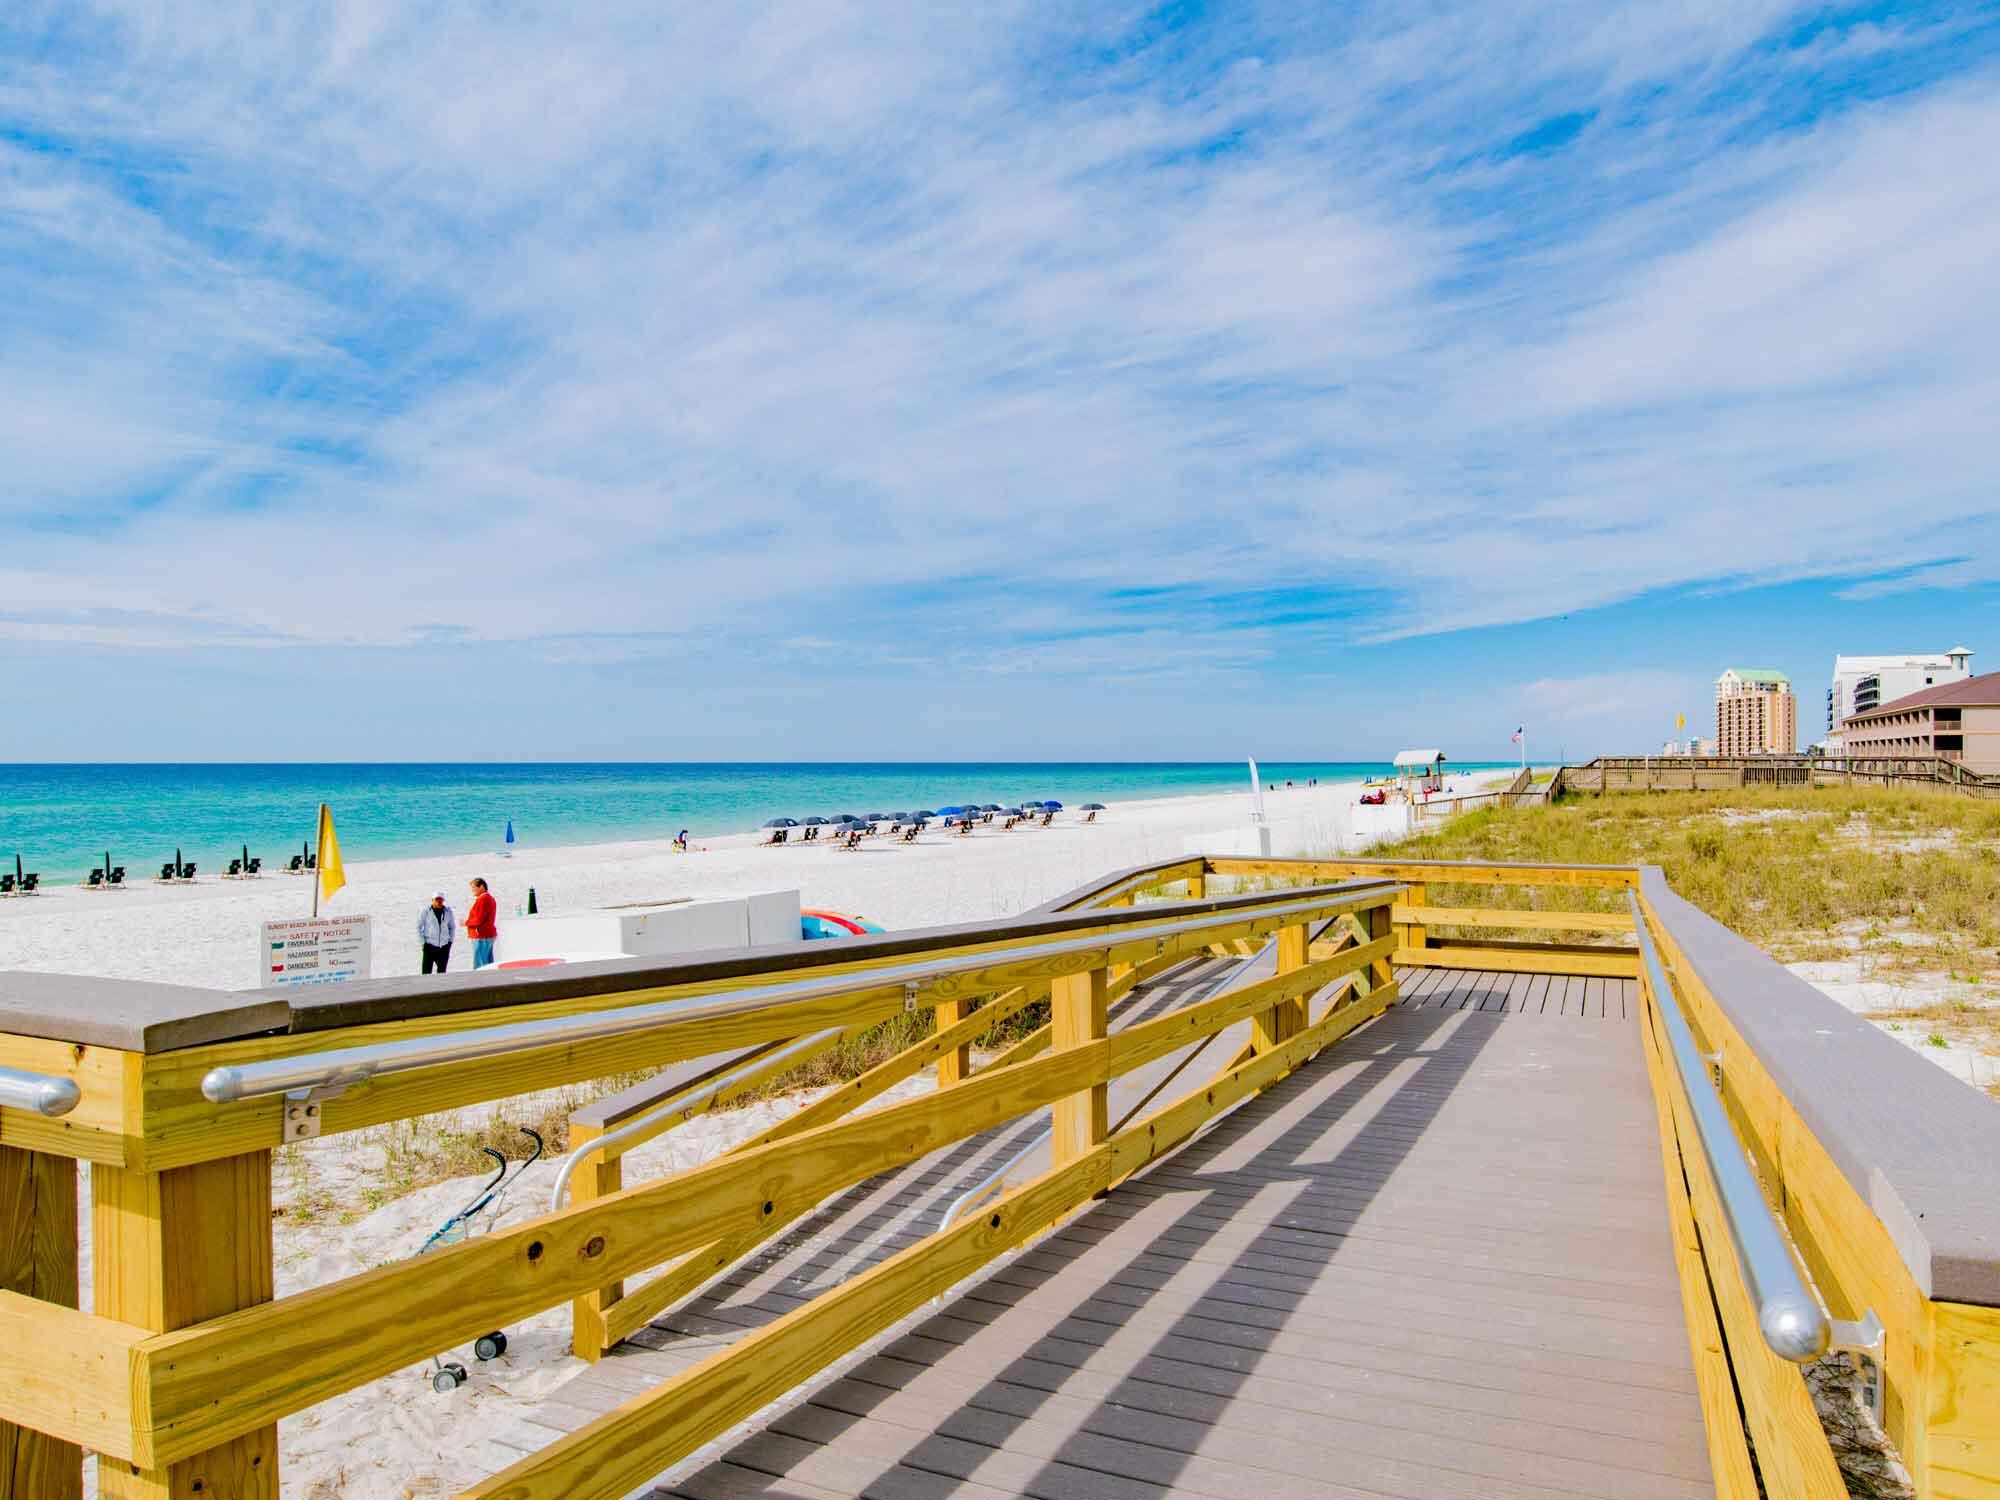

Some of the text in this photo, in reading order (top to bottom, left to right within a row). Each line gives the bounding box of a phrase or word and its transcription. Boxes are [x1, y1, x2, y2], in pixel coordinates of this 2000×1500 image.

[289, 932, 320, 940] SAFETY
[323, 929, 352, 937] NOTICE
[287, 961, 319, 970] DANGEROUS
